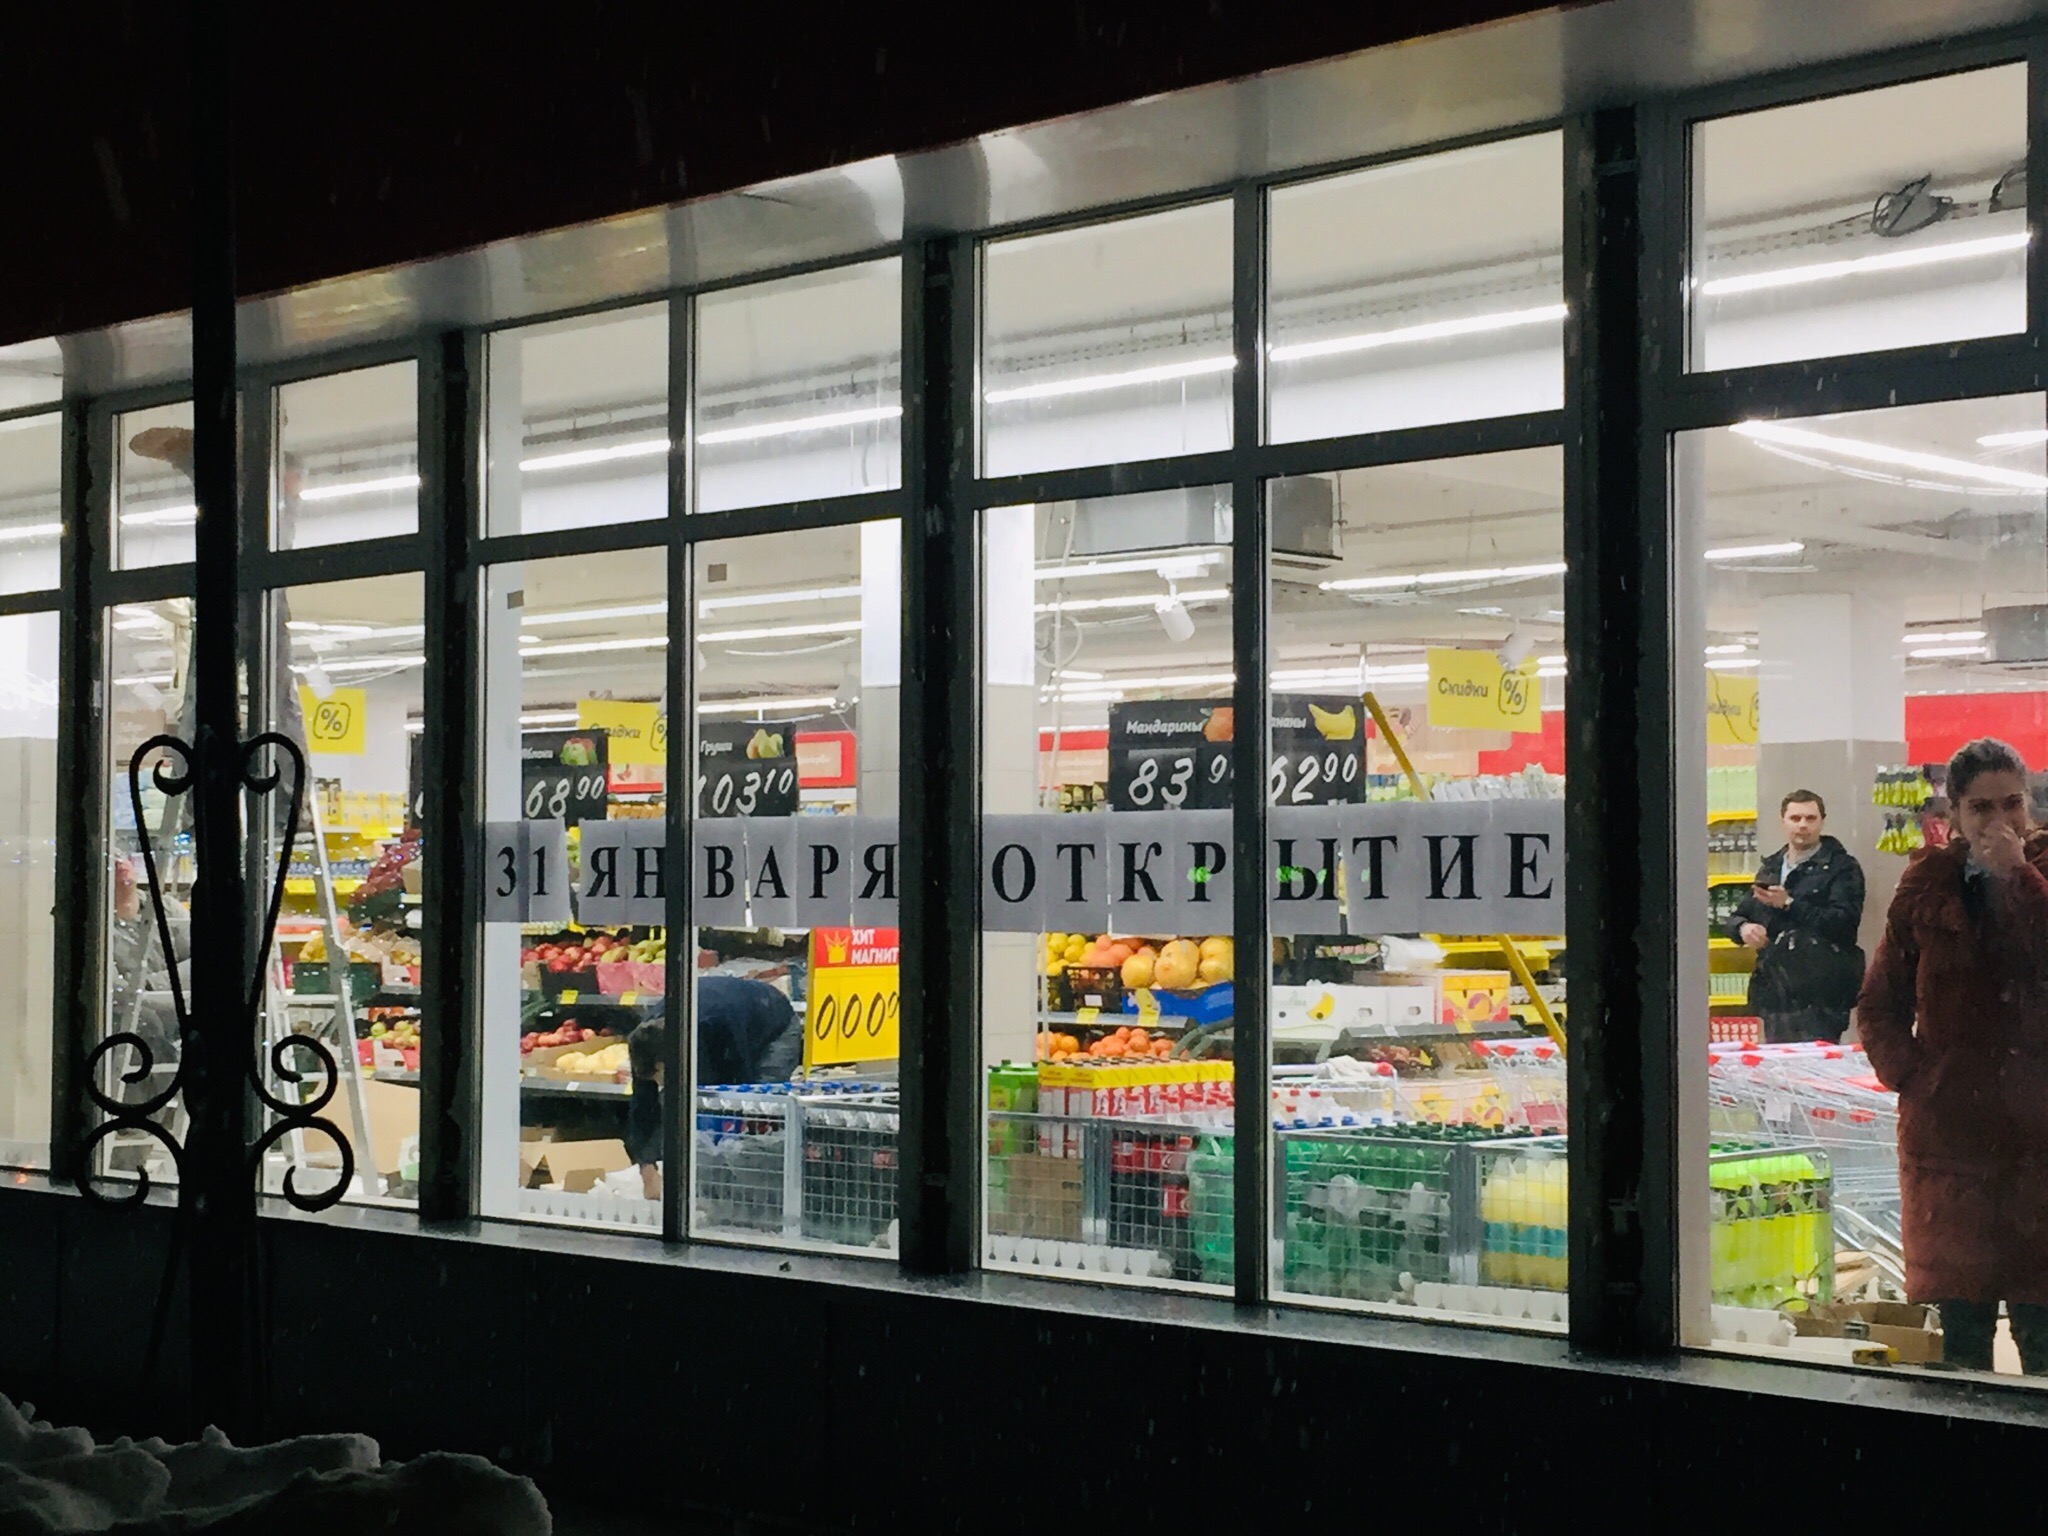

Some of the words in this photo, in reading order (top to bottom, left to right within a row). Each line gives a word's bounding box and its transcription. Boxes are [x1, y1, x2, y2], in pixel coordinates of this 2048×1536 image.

[1125, 719, 1203, 737] Мандарины
[1271, 717, 1307, 729] ананы
[496, 846, 549, 897] 31
[585, 844, 899, 899] ЯНВАРЯ
[991, 832, 1554, 903] ОТКРЫТИЕ
[851, 929, 876, 946] ХИТ
[851, 946, 899, 965] МАГНИТ
